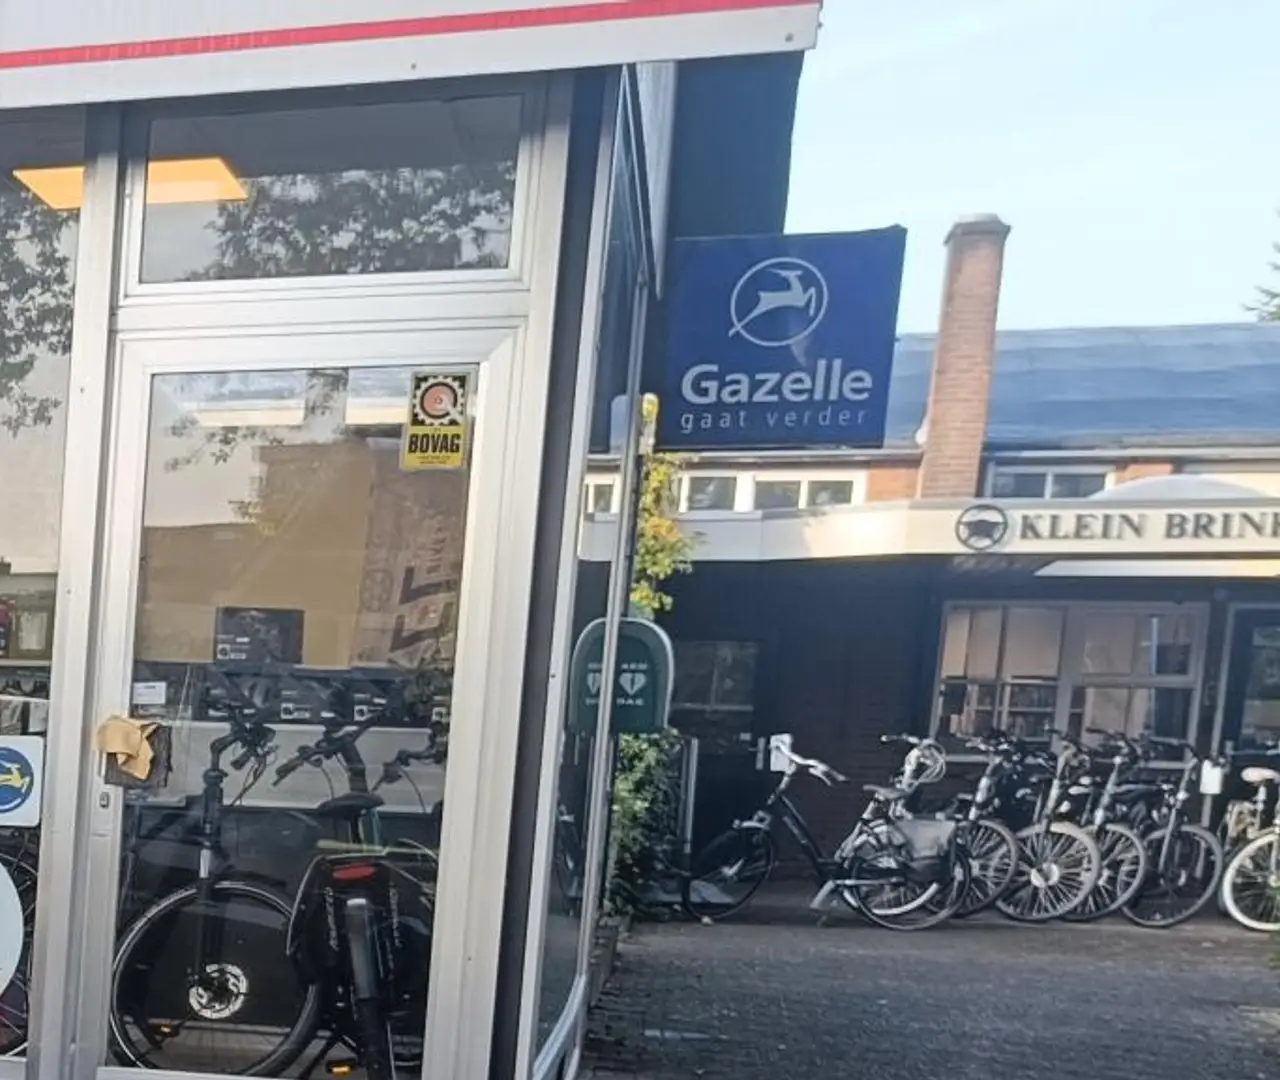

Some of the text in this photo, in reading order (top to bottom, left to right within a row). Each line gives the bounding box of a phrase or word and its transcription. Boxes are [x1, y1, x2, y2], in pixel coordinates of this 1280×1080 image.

[681, 358, 873, 404] Gazelle
[680, 406, 866, 433] gaat verder
[408, 433, 461, 453] BOVAG
[1019, 512, 1147, 540] KLEIN
